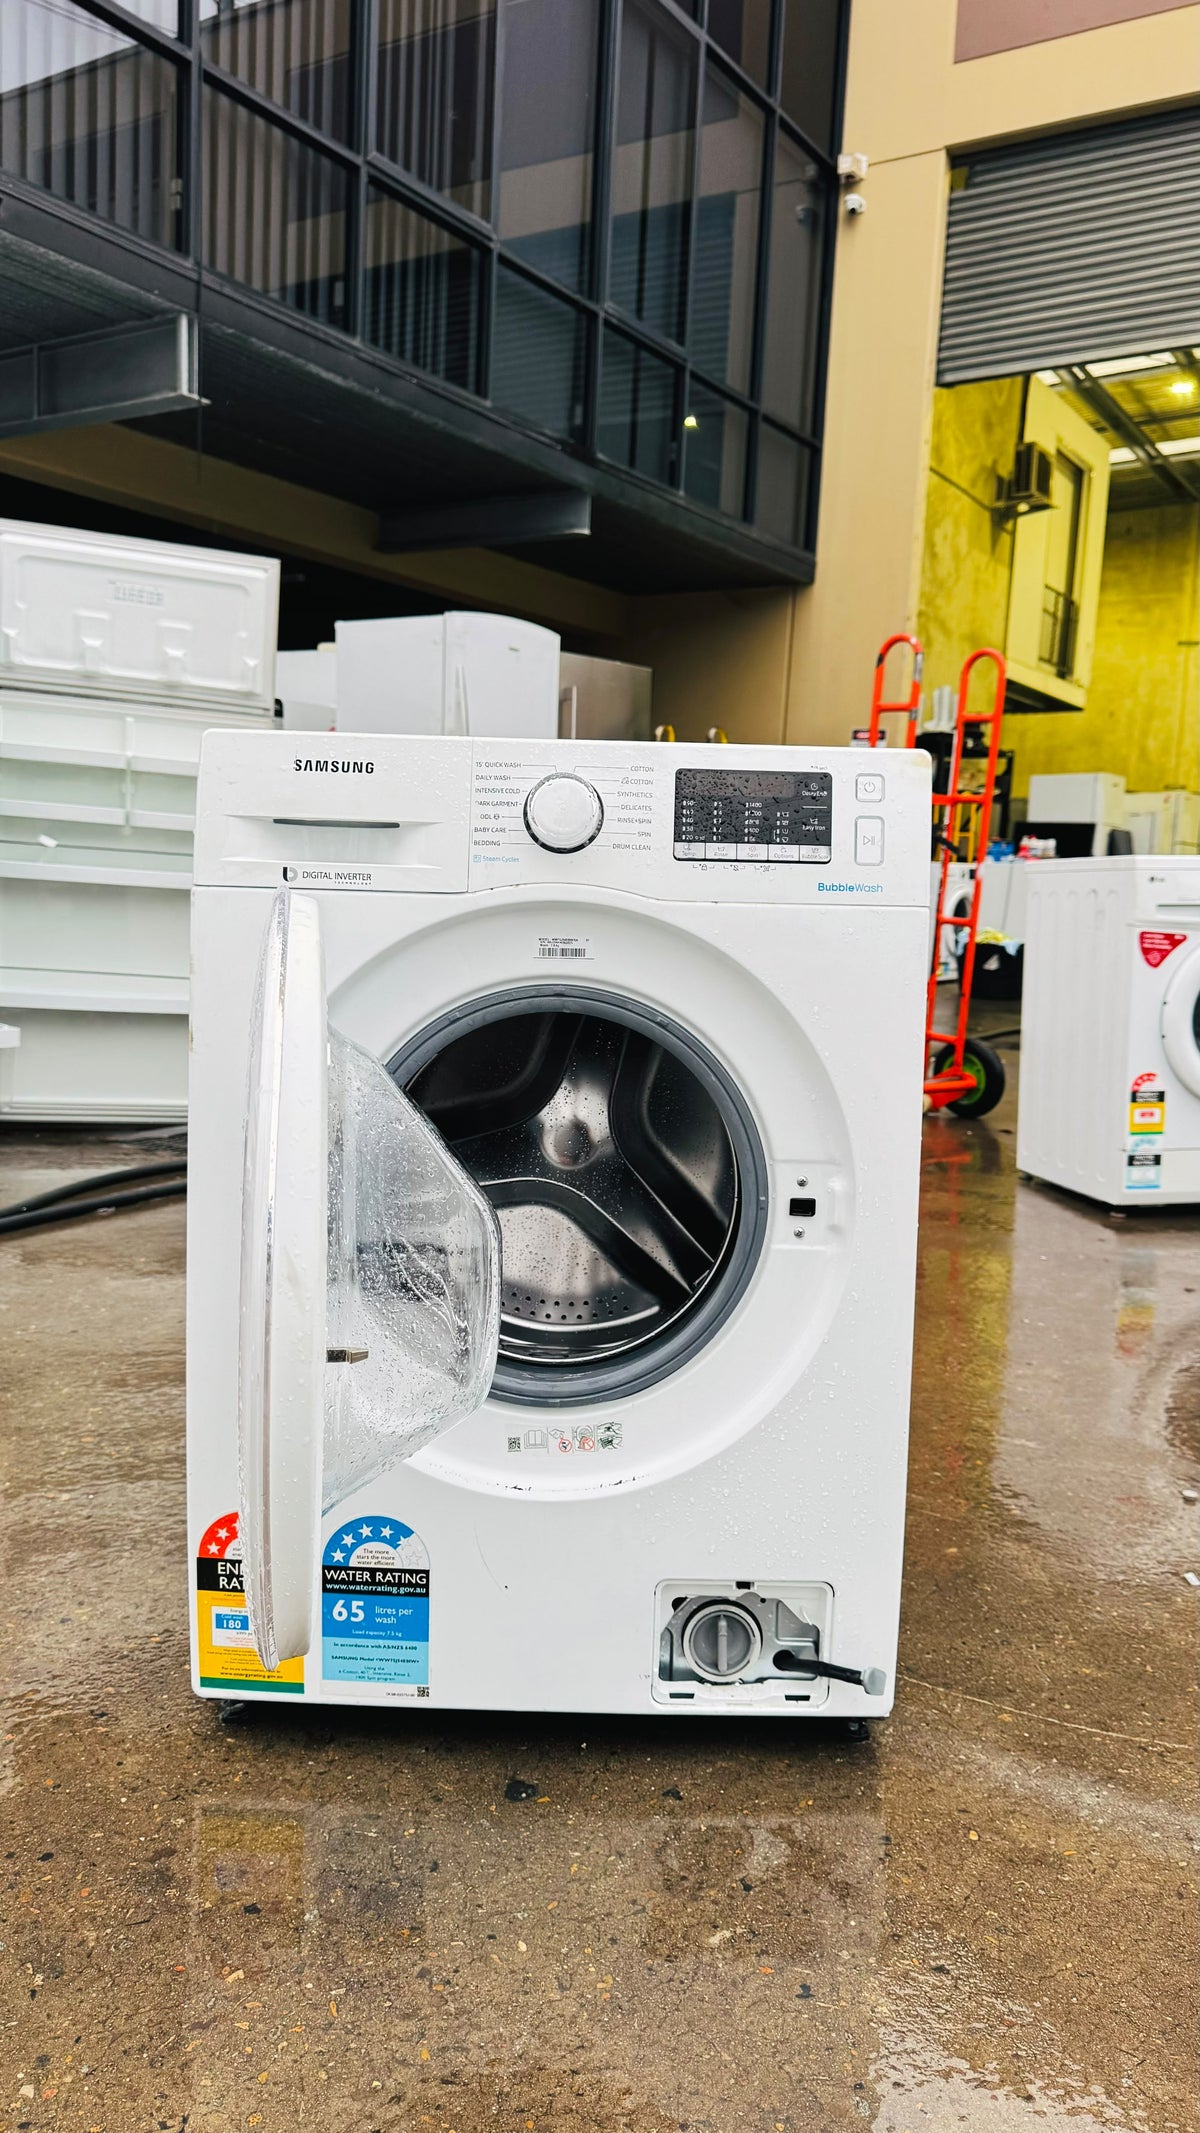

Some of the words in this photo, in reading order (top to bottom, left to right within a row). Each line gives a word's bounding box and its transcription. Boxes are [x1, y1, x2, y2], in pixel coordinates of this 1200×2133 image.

[294, 759, 375, 774] SAMSUNG
[501, 855, 520, 863] Cycles
[302, 871, 333, 879] DIGITAL
[334, 872, 372, 881] INVERTER
[817, 882, 884, 893] BubbleWash
[324, 1569, 372, 1582] WATER
[376, 1571, 427, 1584] RATING
[325, 1583, 426, 1594] www.waterrating.gov.au
[332, 1599, 365, 1622] 65
[375, 1606, 396, 1615] litres
[398, 1608, 413, 1617] per
[223, 1619, 241, 1629] 180
[375, 1616, 397, 1624] wash
